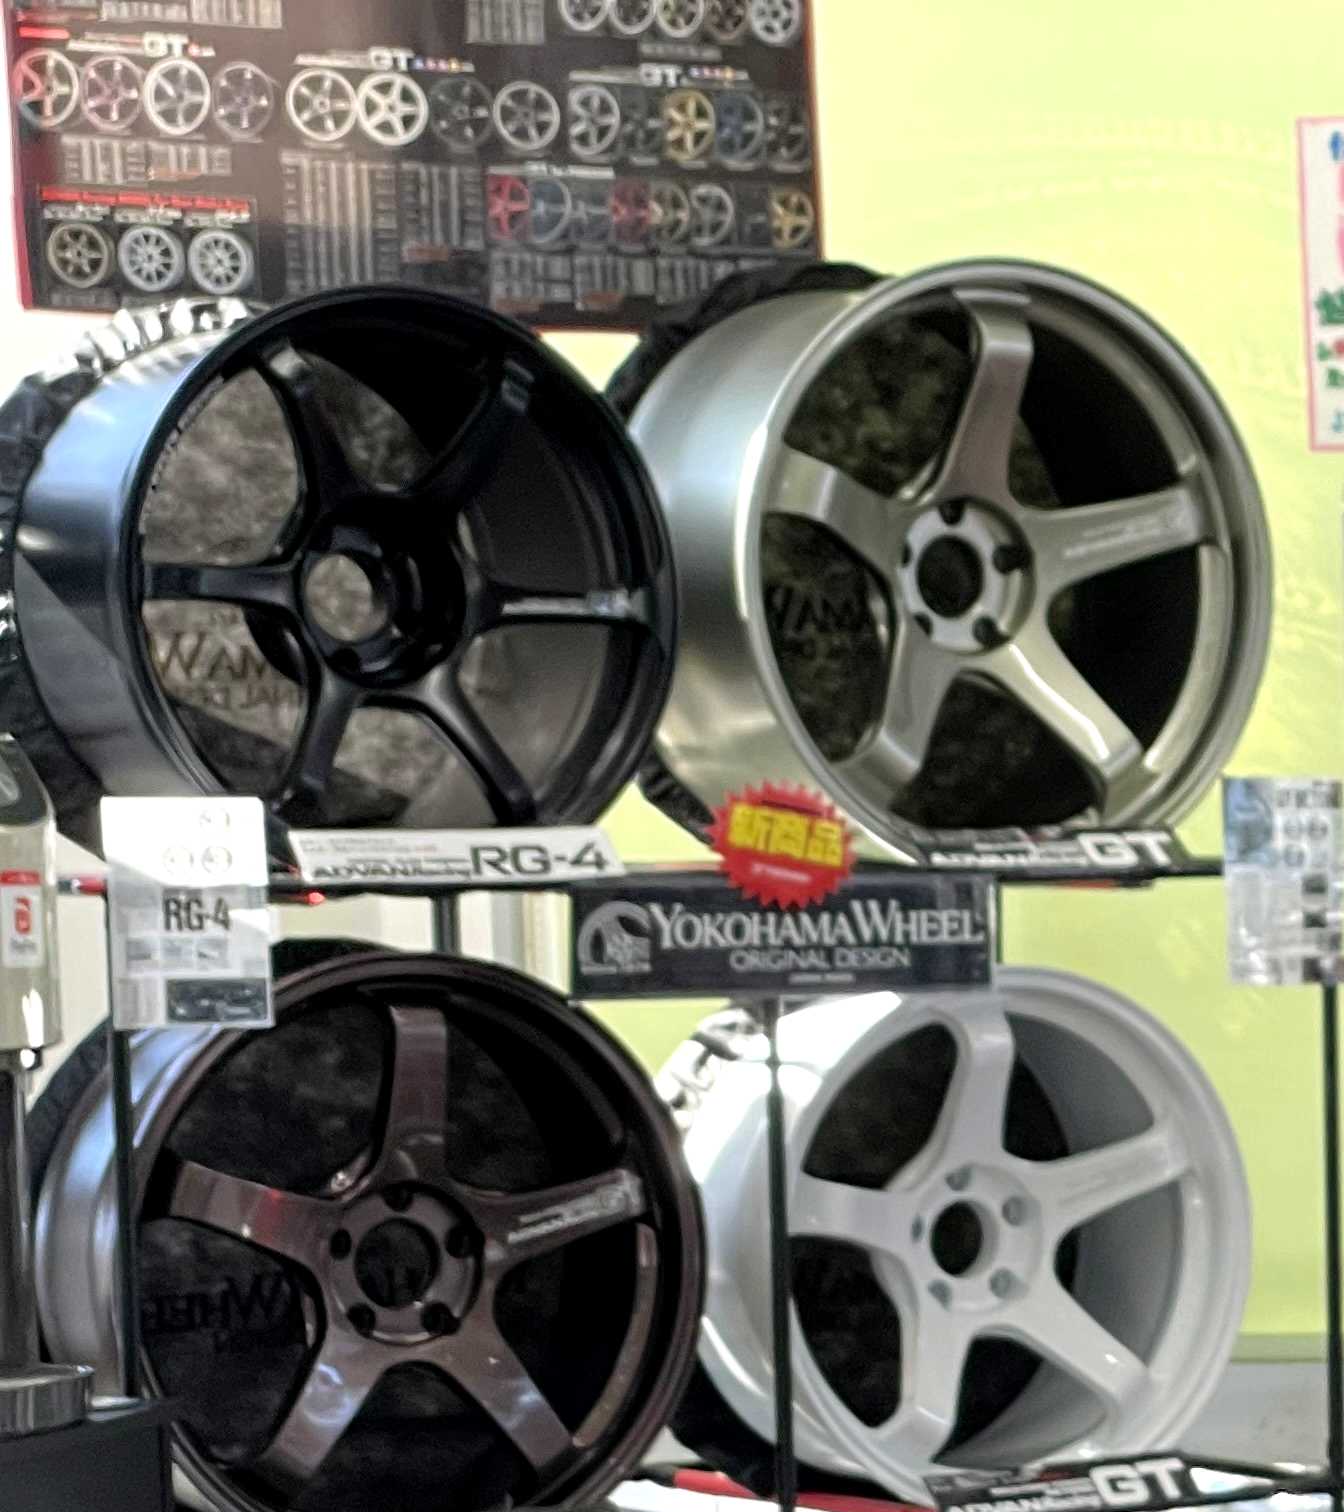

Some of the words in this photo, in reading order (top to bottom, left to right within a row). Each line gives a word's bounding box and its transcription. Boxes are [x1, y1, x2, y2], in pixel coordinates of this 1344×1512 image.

[470, 841, 609, 877] RG-4
[1079, 830, 1174, 868] GT
[162, 897, 231, 932] RG-4
[651, 902, 854, 951] YOKOHAMA
[849, 898, 984, 945] WHEEL
[729, 947, 830, 972] ORIGINAL
[833, 946, 911, 969] DESIGN
[1090, 1457, 1185, 1509] GT
